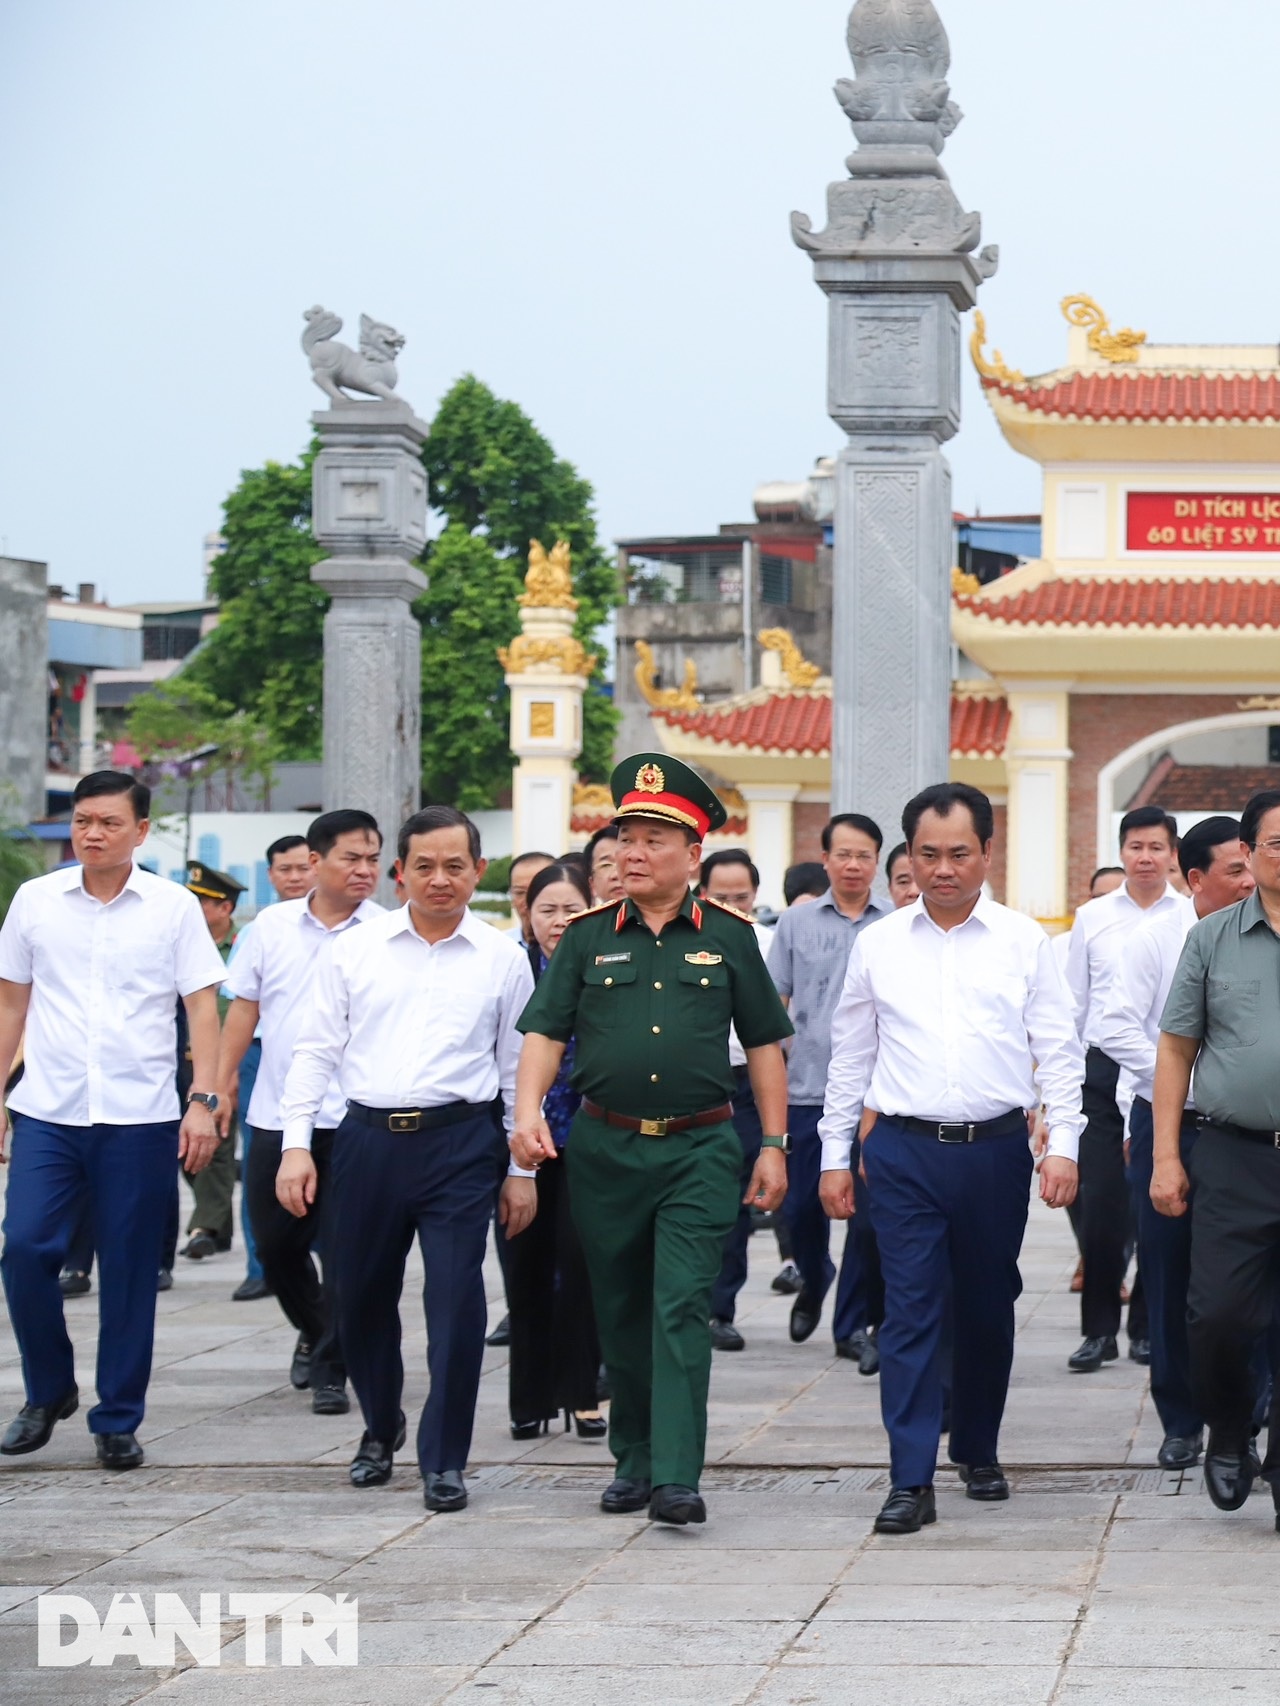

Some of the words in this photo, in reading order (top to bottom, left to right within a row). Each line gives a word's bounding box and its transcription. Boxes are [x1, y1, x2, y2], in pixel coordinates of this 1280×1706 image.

[1175, 500, 1197, 518] DI
[1203, 495, 1246, 518] TÍCH
[1147, 526, 1176, 544] 60
[1182, 523, 1225, 549] LIỆT
